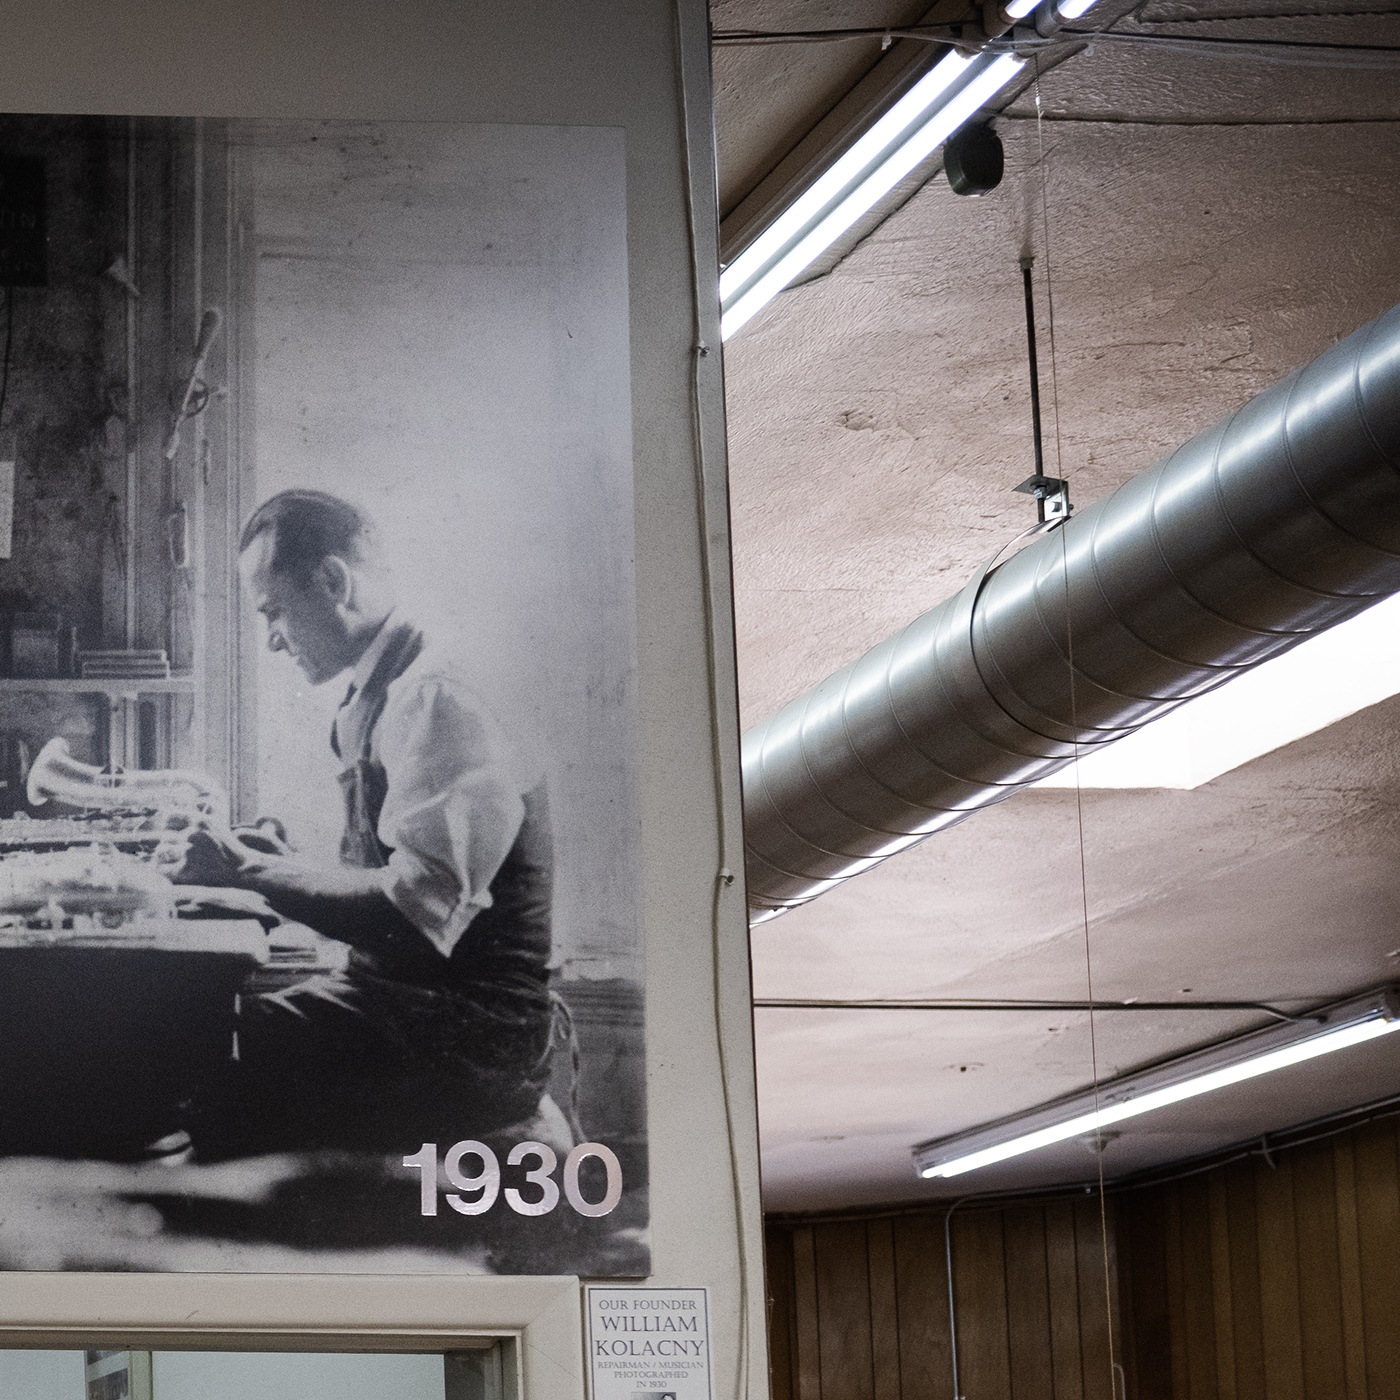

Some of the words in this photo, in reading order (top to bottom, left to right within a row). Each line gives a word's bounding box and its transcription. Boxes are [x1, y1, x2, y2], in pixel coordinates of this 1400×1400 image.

[402, 1140, 623, 1217] 1930
[599, 1300, 629, 1310] OUR
[634, 1300, 697, 1311] FOUNDER
[600, 1316, 698, 1332] WILLIAM
[596, 1340, 705, 1356] KOLACNY
[598, 1361, 649, 1369] REPAIRMAN
[659, 1361, 704, 1369] MUSICIAN
[614, 1370, 689, 1379] PHOTOGRAPHED
